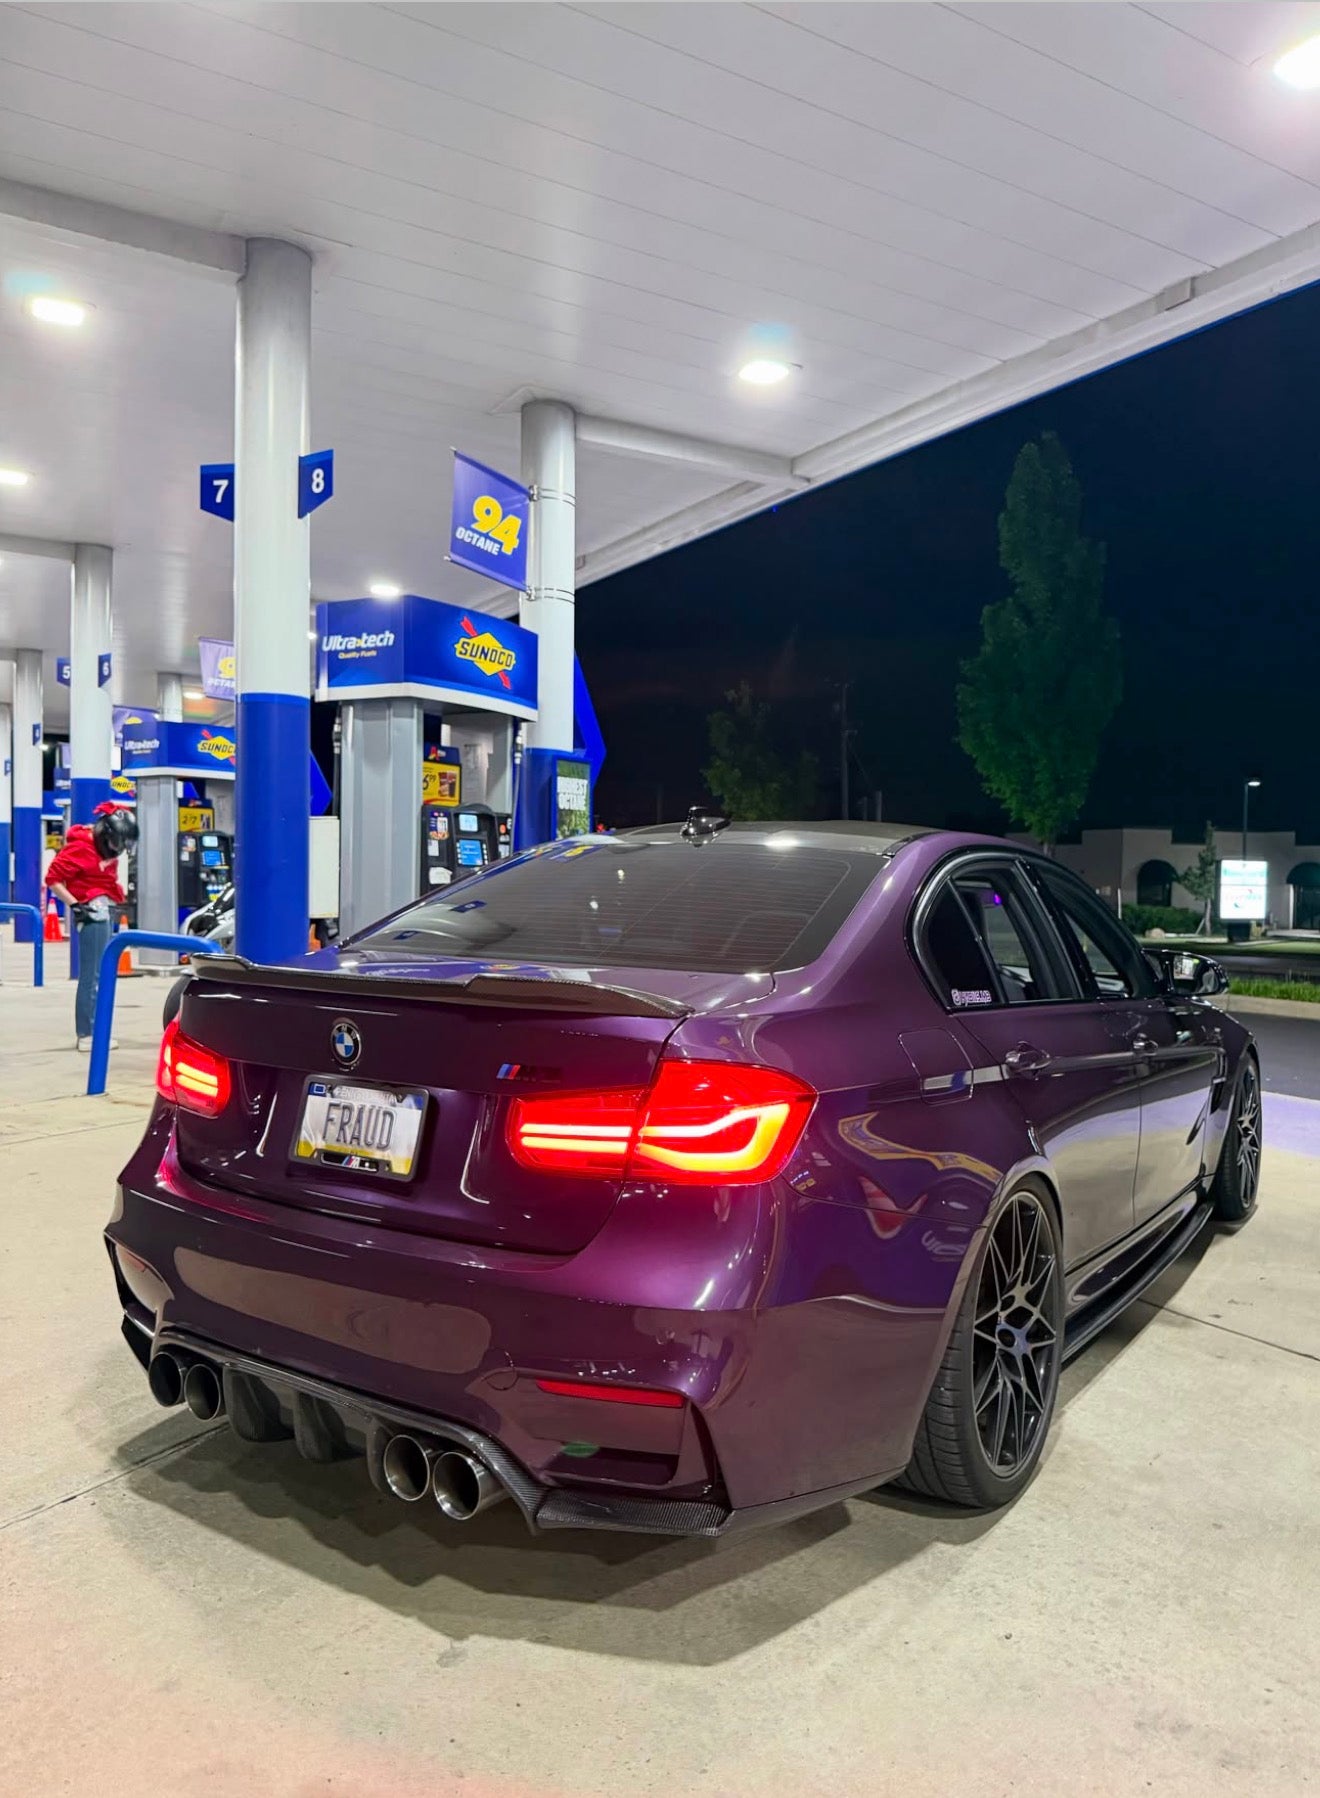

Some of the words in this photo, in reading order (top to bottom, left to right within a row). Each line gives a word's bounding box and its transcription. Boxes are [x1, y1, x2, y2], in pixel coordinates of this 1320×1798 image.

[213, 479, 229, 503] 7
[311, 468, 325, 494] 8
[470, 495, 522, 556] 94
[455, 526, 501, 556] OCTANE
[458, 641, 513, 668] SUNOCO
[62, 665, 71, 680] 5
[103, 661, 110, 676] 6
[218, 656, 236, 680] 9
[200, 742, 236, 755] SUNOC
[322, 1102, 395, 1151] FRAUD
